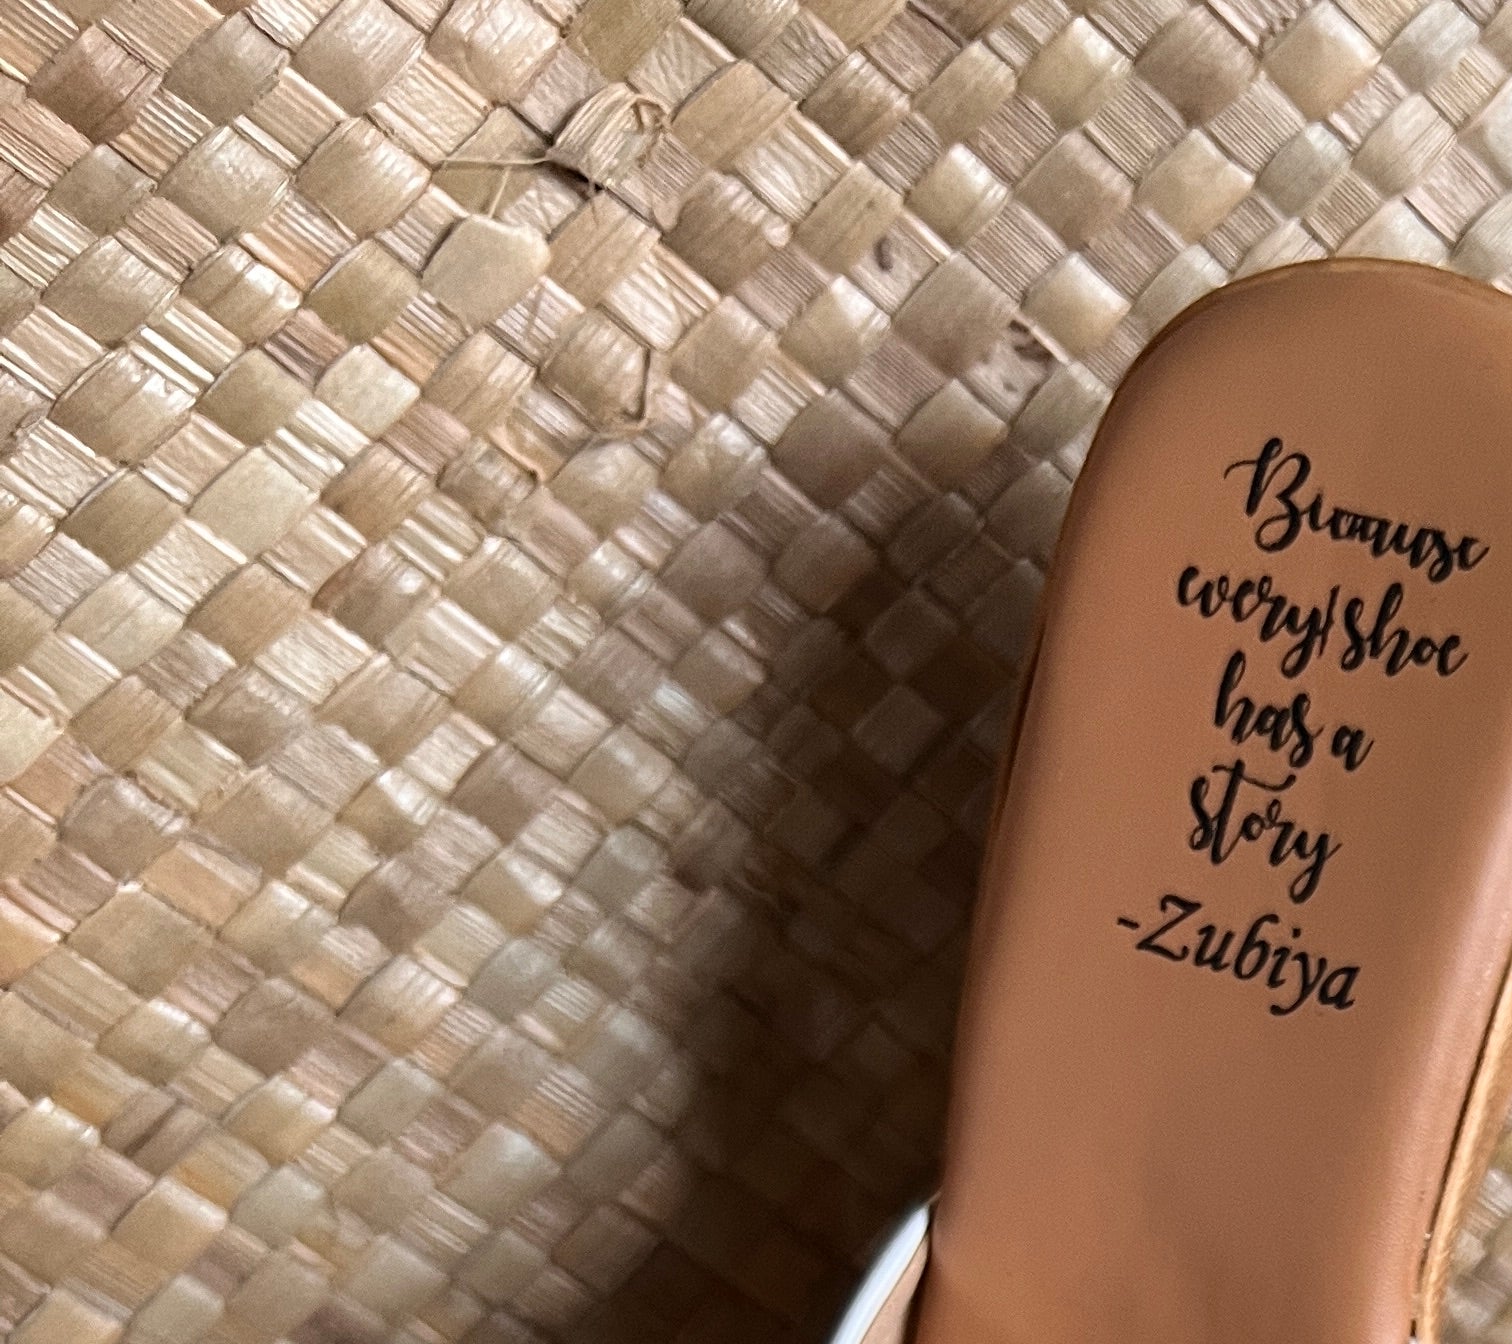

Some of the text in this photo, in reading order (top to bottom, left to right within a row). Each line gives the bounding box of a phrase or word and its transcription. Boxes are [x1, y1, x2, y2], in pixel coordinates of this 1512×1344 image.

[1214, 650, 1374, 771] has a
[1189, 759, 1343, 904] story
